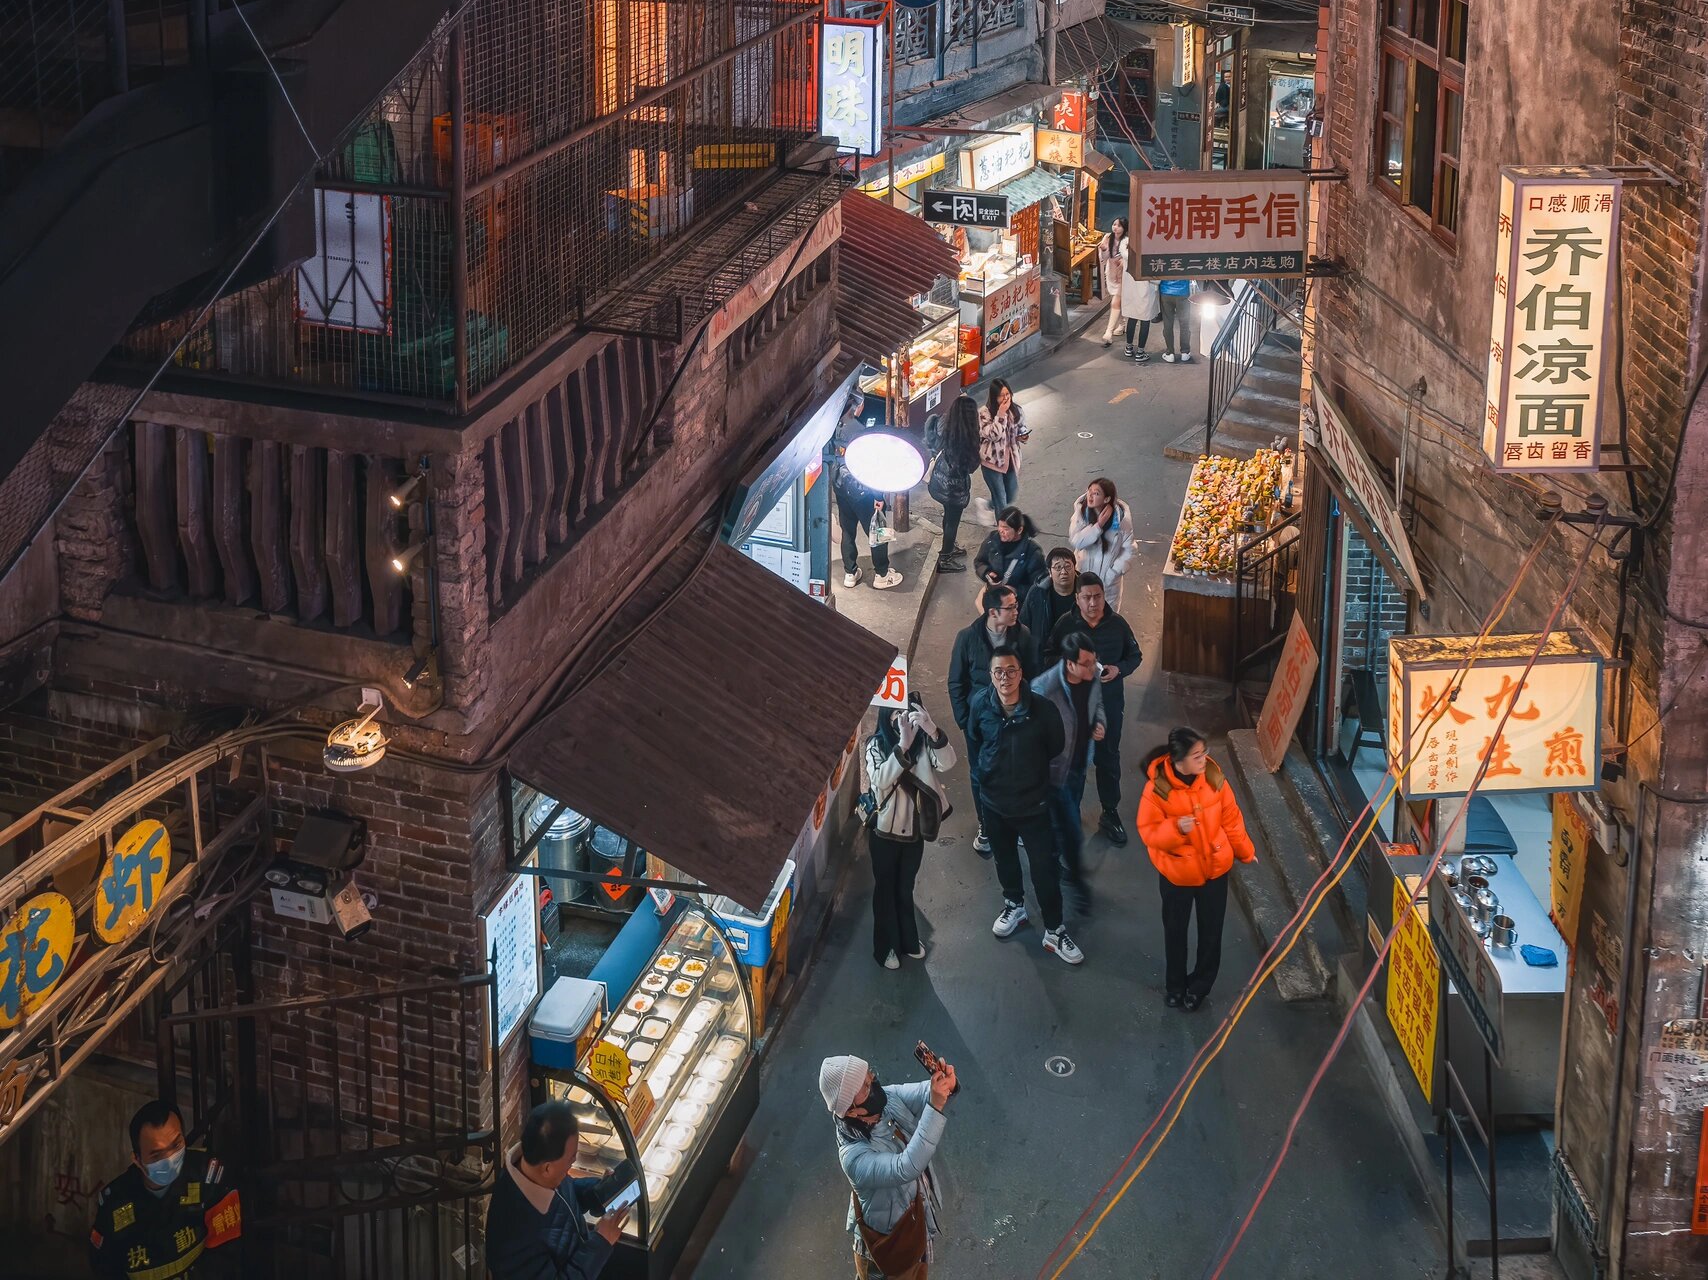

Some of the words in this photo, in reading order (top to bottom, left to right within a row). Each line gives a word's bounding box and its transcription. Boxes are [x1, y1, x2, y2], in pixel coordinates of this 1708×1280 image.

[827, 30, 869, 128] 明珠
[979, 208, 1000, 216] 安全出口
[1147, 192, 1300, 241] 湖南手信
[1529, 193, 1614, 214] 口感顺滑
[1149, 255, 1296, 273] 请至二楼店内选购
[989, 278, 1037, 322] 葱油粑粑
[1487, 212, 1512, 429] 乔伯凉面
[1514, 227, 1603, 438] 乔伯凉面
[1504, 440, 1592, 461] 唇齿留香
[1322, 402, 1400, 553] 乔伯凉面
[1417, 675, 1540, 724] 牧九
[1426, 737, 1440, 790] 唇齿留香
[1477, 726, 1587, 779] 生煎
[102, 827, 165, 930] 虾
[1392, 948, 1432, 1038] 唇齿留香
[1396, 982, 1426, 1057] 可打包
[1649, 1051, 1698, 1066] 门面转让
[127, 1226, 197, 1269] 执勤
